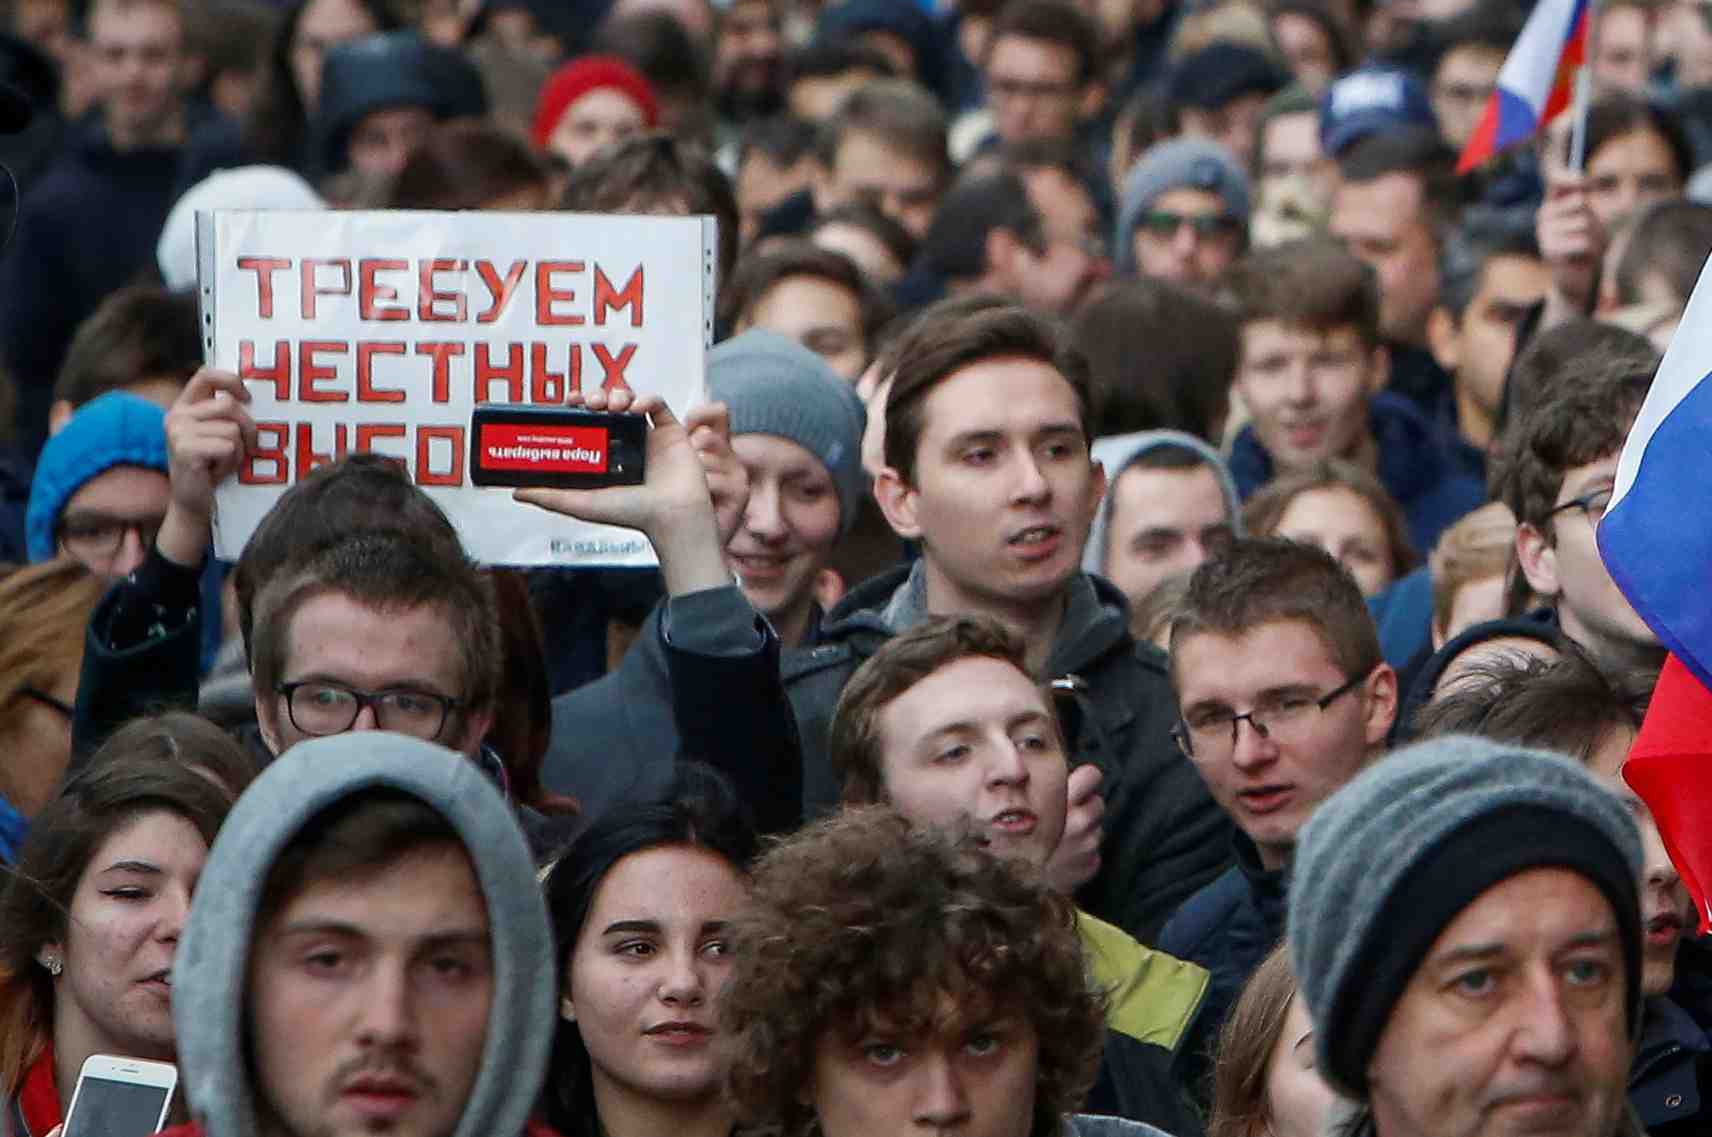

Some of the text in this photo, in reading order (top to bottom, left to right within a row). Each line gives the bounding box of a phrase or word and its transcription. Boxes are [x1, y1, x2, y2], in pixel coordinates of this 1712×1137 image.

[237, 258, 643, 327] ТРЕБУЕМ
[238, 340, 639, 404] ЧЕСТНЫХ
[488, 445, 601, 465] Пора выбирать
